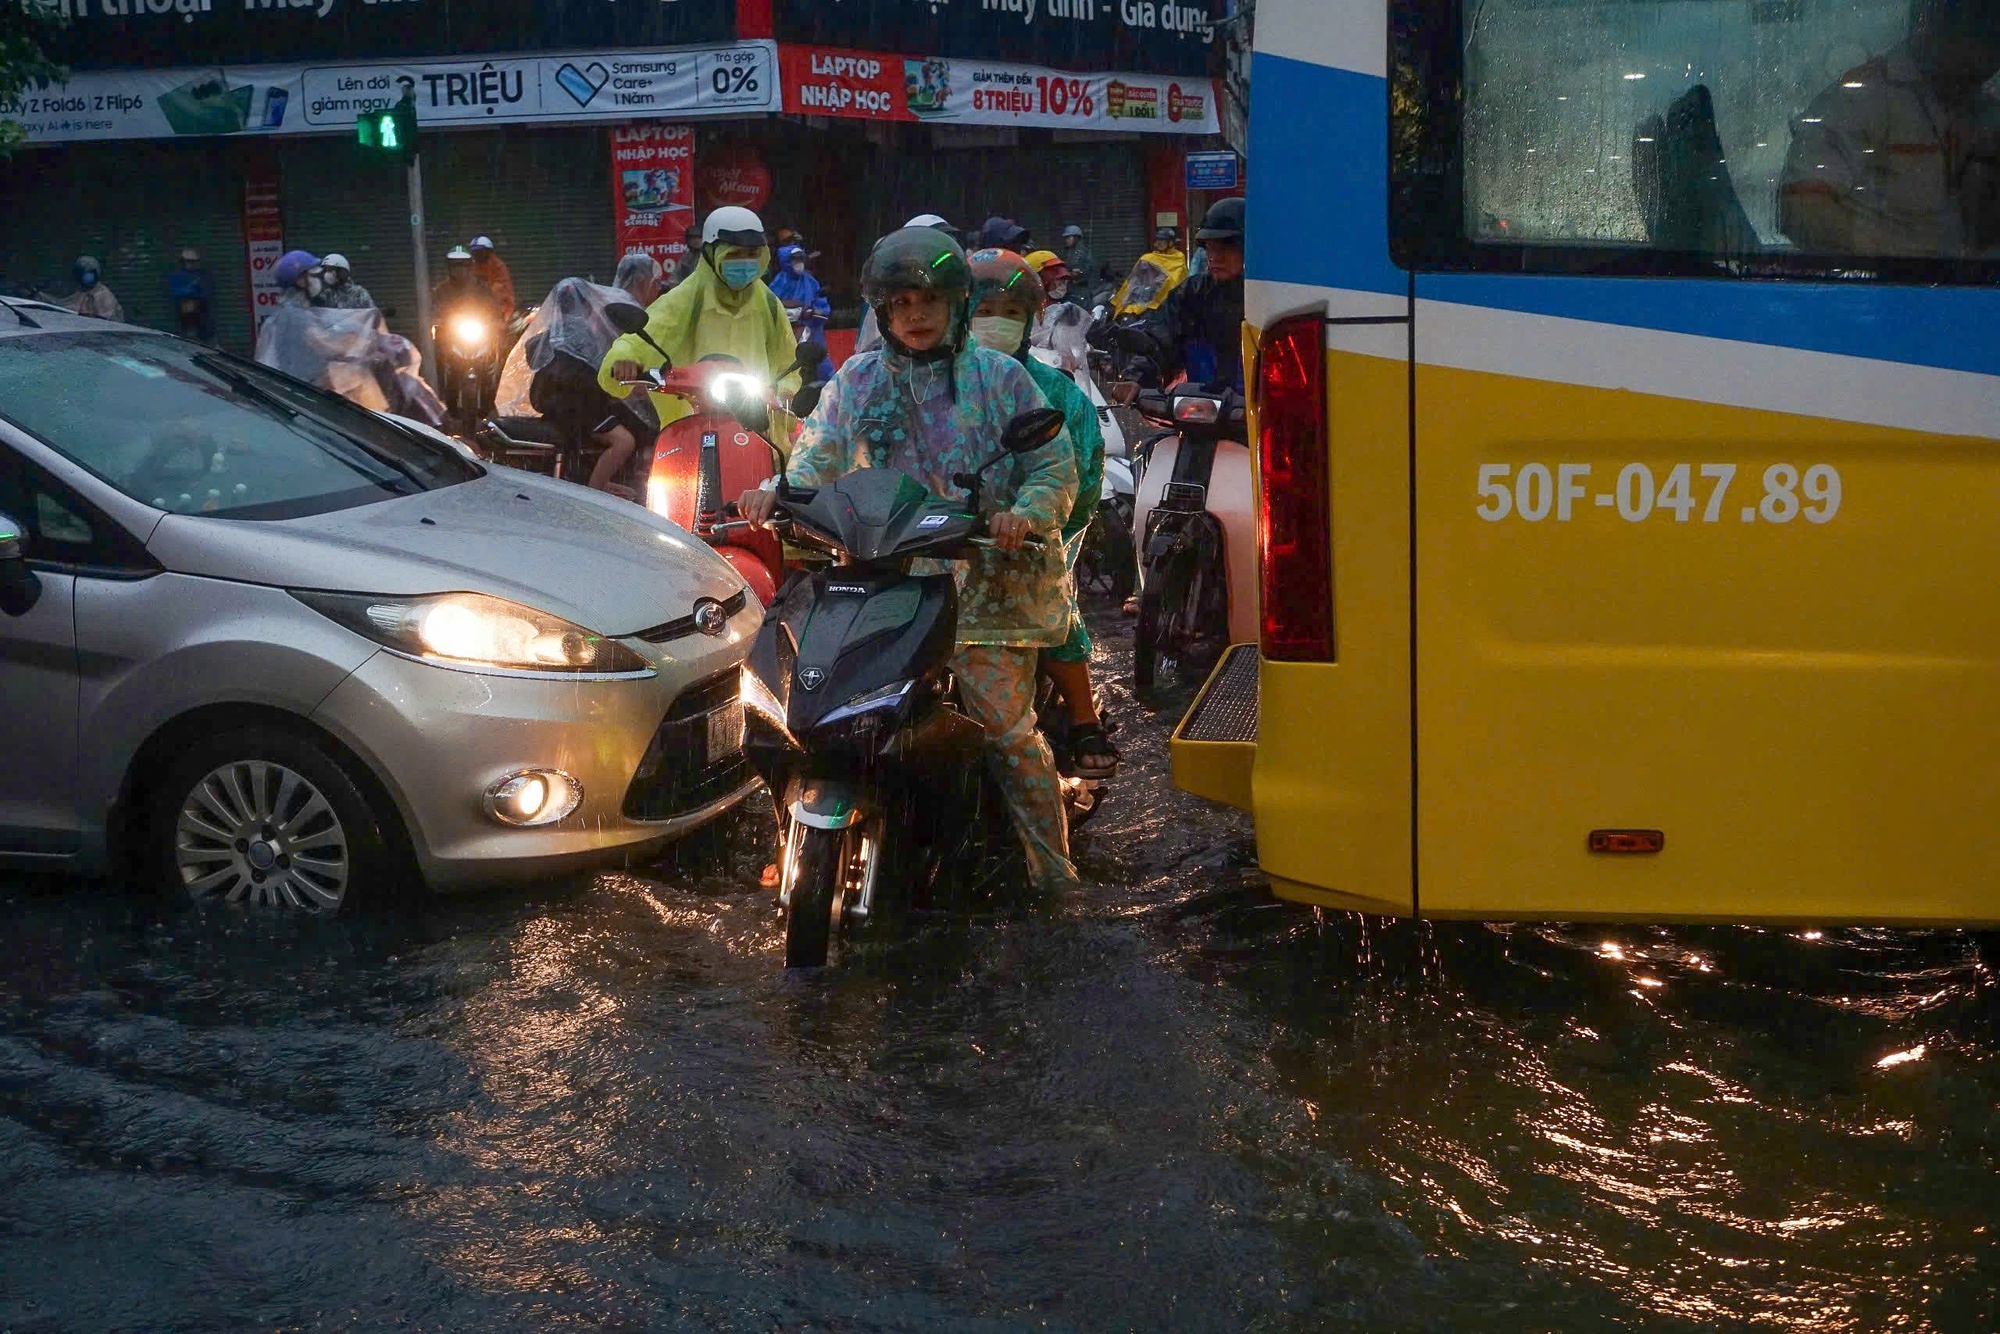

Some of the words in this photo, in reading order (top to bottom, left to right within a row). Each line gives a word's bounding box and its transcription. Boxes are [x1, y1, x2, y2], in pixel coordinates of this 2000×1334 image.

[735, 51, 756, 65] góp
[811, 54, 881, 79] LAPTOP
[612, 61, 677, 76] Samsung
[972, 68, 993, 83] GIẢM
[337, 76, 364, 91] Lên
[366, 75, 391, 90] đời
[612, 77, 654, 90] Care+
[712, 65, 759, 94] 0%
[421, 62, 524, 115] TRIỆU
[1036, 75, 1094, 117] 10%
[30, 98, 40, 113] Z
[43, 97, 86, 112] Fold6
[94, 96, 104, 111] Z
[106, 93, 143, 115] Flip6
[311, 95, 350, 115] giảm
[352, 97, 392, 114] ngay
[621, 91, 655, 105] Năm
[801, 81, 852, 113] NHẬP
[855, 89, 892, 115] HỌC
[615, 125, 690, 143] LAPTOP
[617, 145, 656, 162] NHẬP
[658, 146, 689, 161] HỌC
[625, 242, 655, 256] GIẢM
[657, 243, 690, 255] THÊM
[1475, 462, 1843, 524] 50F-047.89
[828, 585, 867, 594] HONDA
